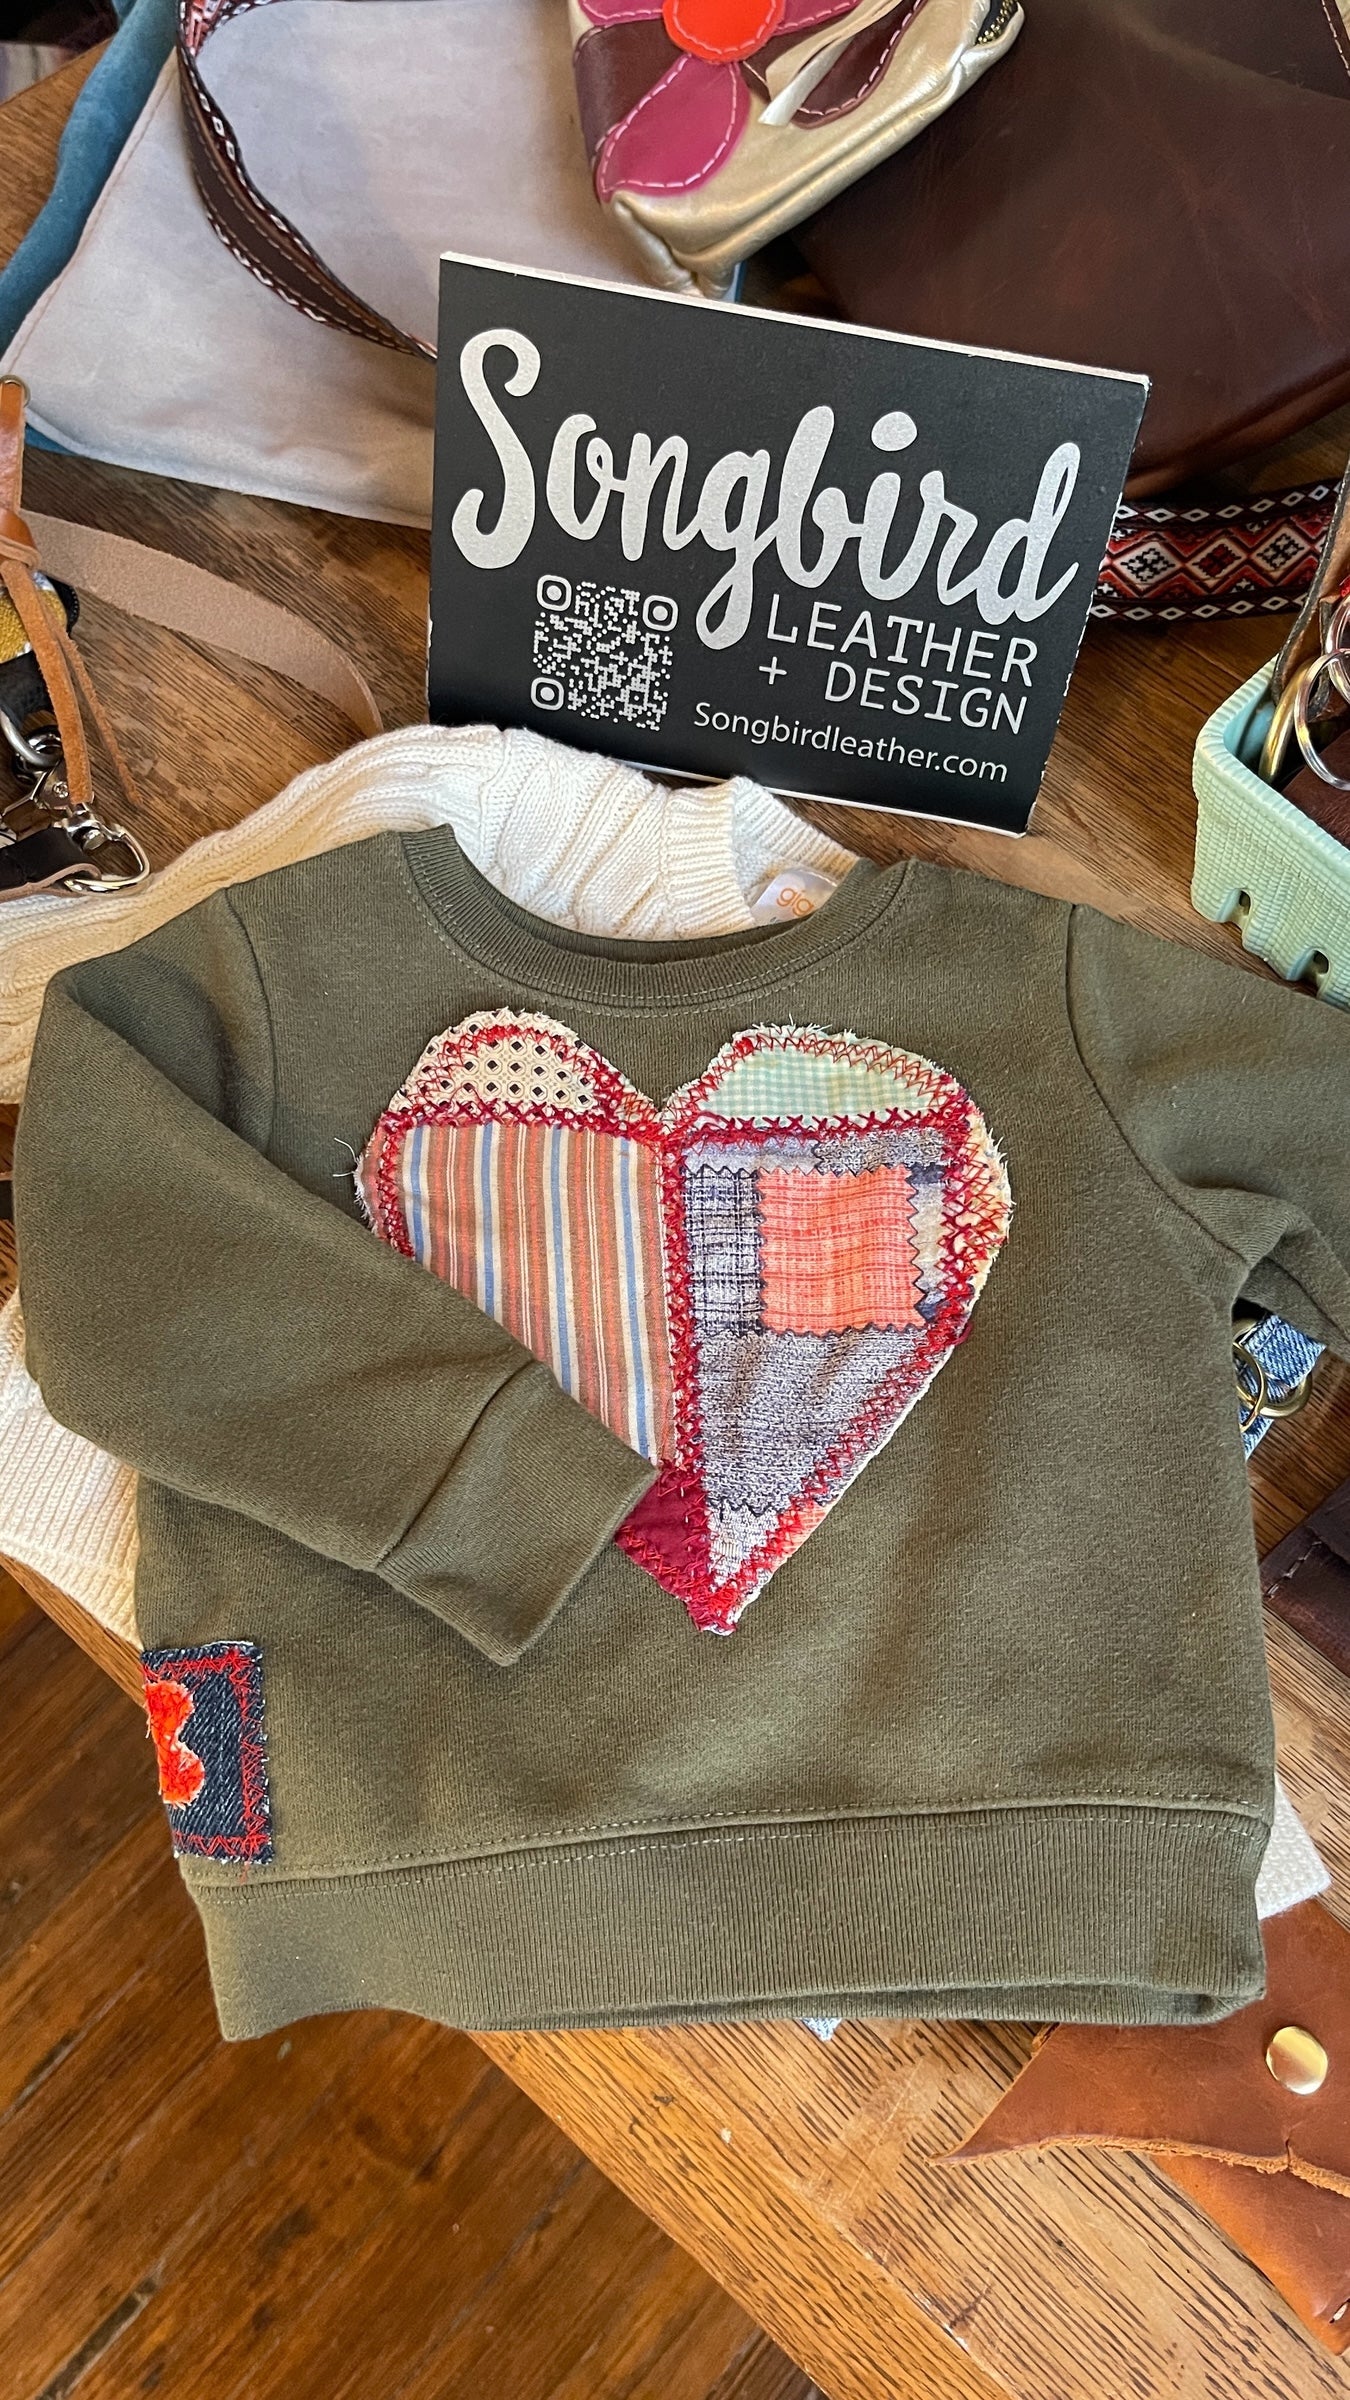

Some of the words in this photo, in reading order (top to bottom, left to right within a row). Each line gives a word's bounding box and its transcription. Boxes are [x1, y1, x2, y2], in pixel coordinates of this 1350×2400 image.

[451, 327, 1081, 650] Songbird
[766, 593, 1038, 687] LEATHER
[758, 656, 788, 685] +
[824, 660, 1028, 735] DESIGN
[693, 701, 1008, 783] Songbirdleather.com
